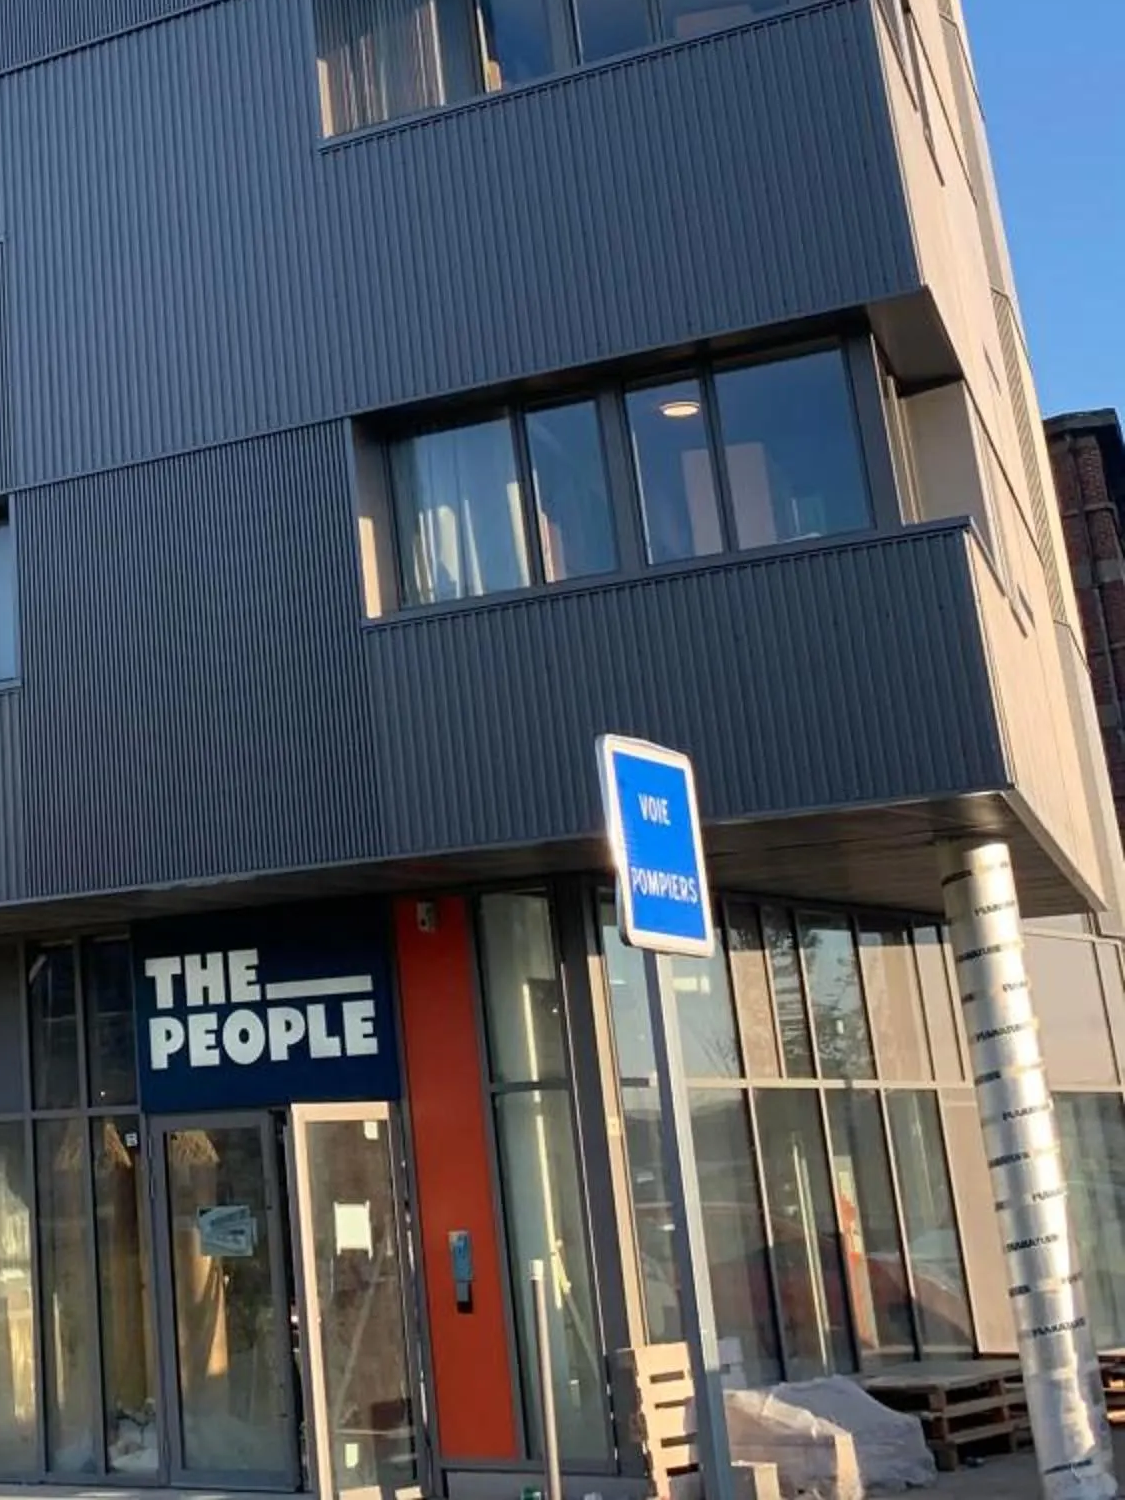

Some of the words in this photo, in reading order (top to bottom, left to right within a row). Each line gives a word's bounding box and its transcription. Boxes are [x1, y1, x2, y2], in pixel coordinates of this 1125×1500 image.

[637, 792, 671, 827] VOIE
[630, 866, 698, 904] POMPIERS
[149, 1000, 379, 1070] PEOPLE
